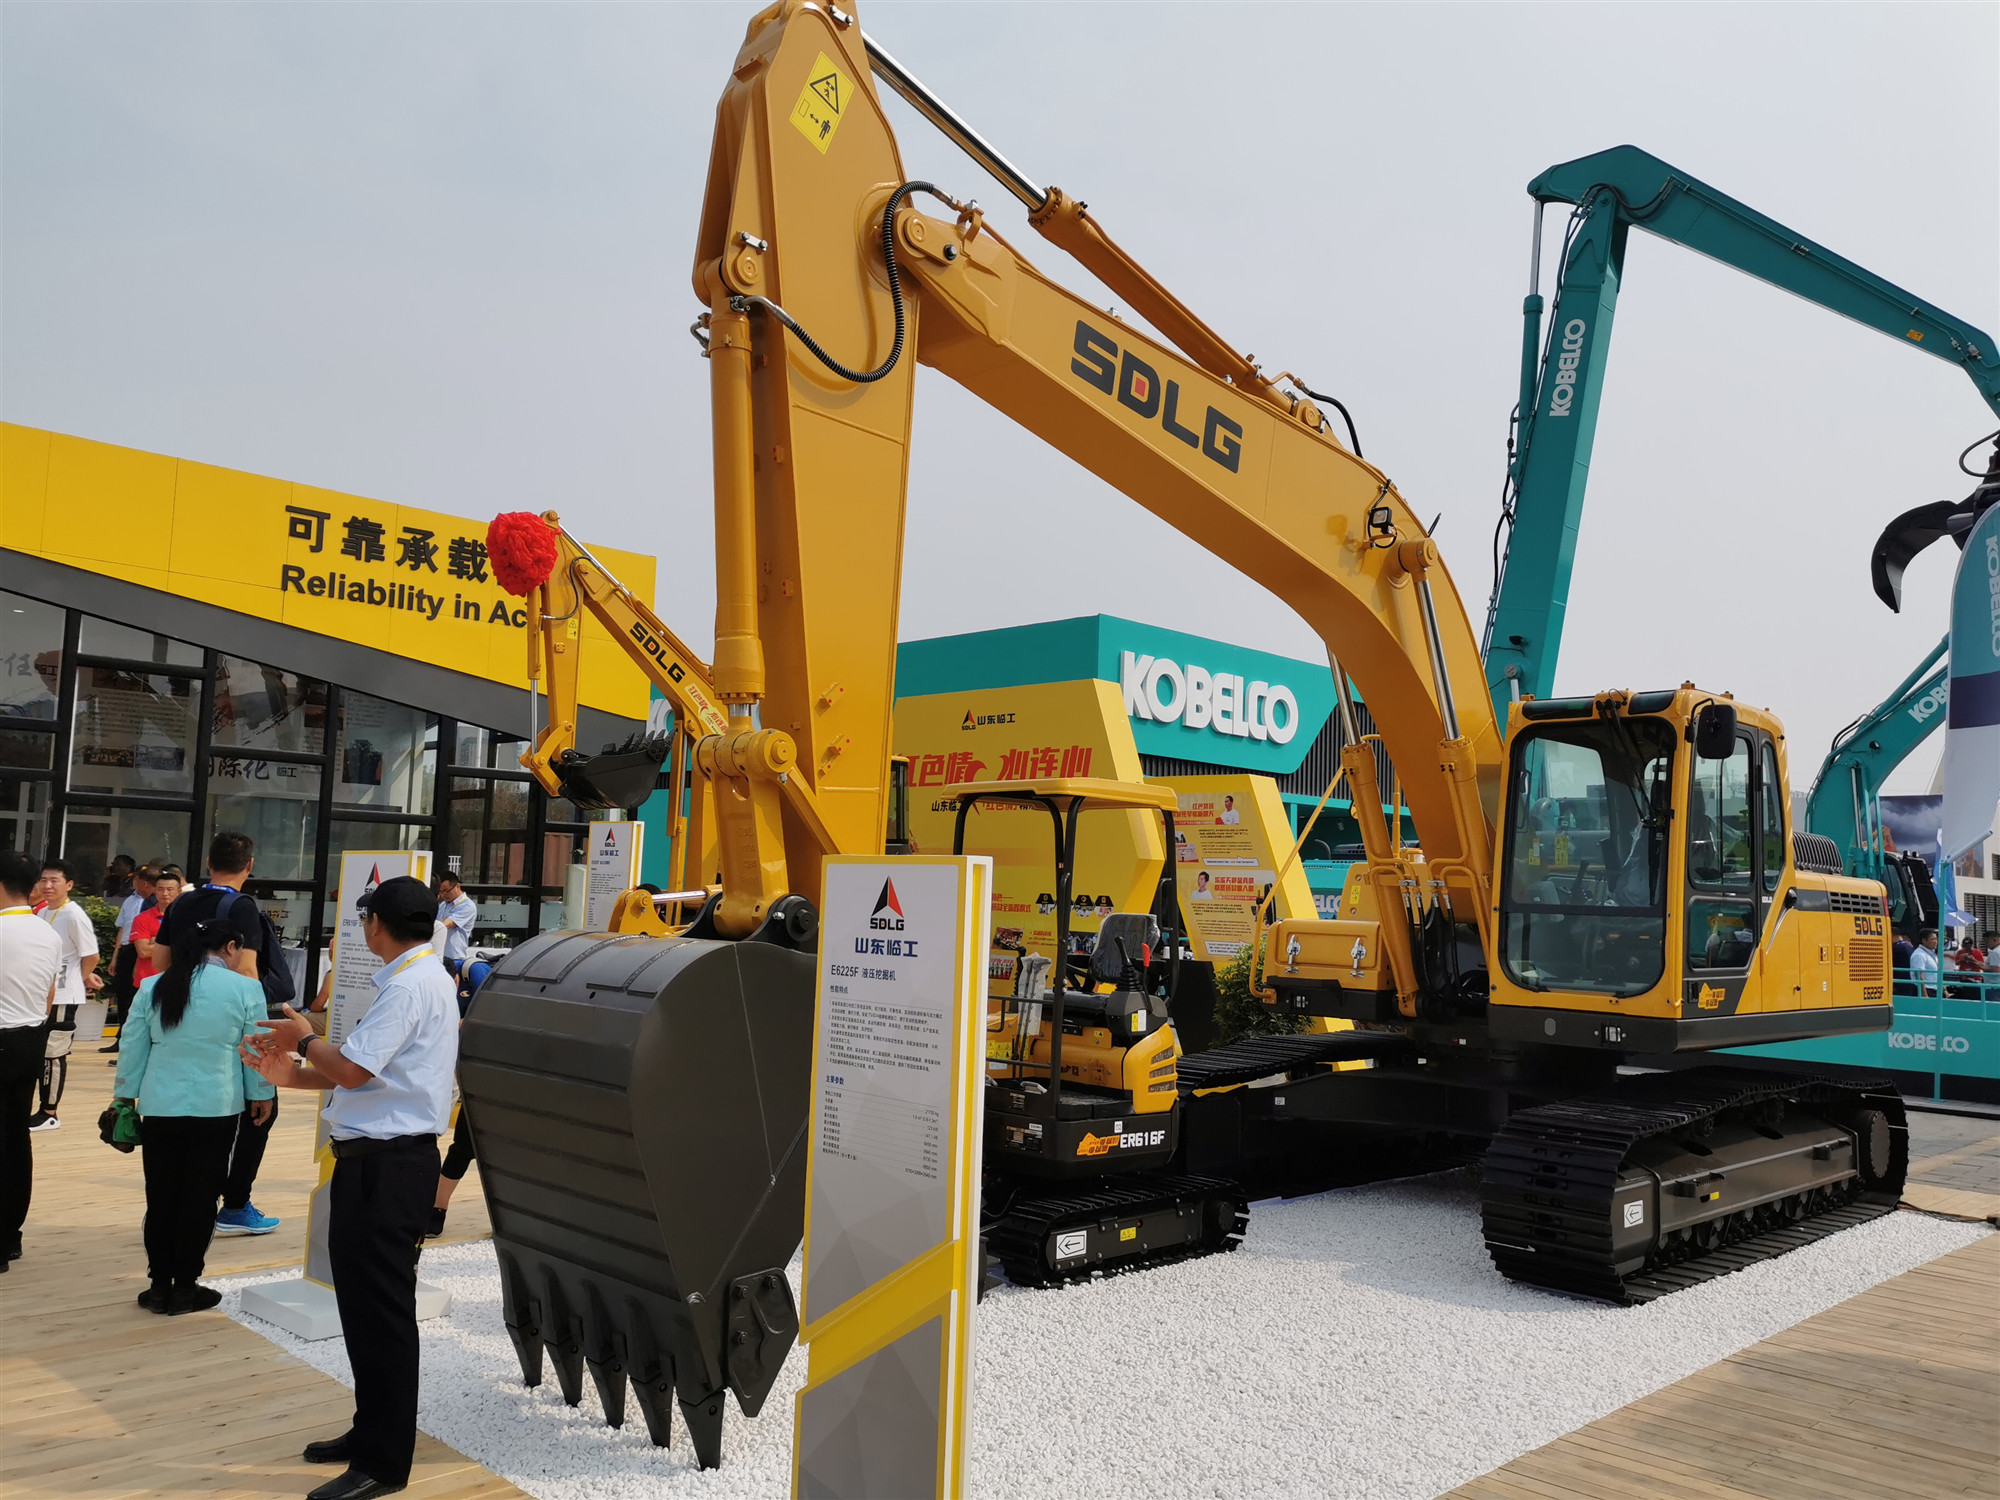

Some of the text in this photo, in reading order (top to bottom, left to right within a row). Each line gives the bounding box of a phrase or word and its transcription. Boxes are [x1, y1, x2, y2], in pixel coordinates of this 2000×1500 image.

[1549, 319, 1586, 416] KOBELCO
[1071, 320, 1242, 474] SDLG
[285, 505, 502, 586] 可靠承载
[281, 564, 528, 628] Reliability in Ac
[630, 621, 686, 684] SDLG
[1120, 650, 1299, 744] KOBELCO
[977, 713, 1016, 726] 山东临工
[870, 917, 905, 931] SDLG
[1854, 916, 1883, 936] SDLG
[855, 937, 918, 958] 山东临工
[831, 964, 859, 977] E6225F
[1887, 1031, 1970, 1053] KOBECO
[1119, 1130, 1166, 1148] ER616F
